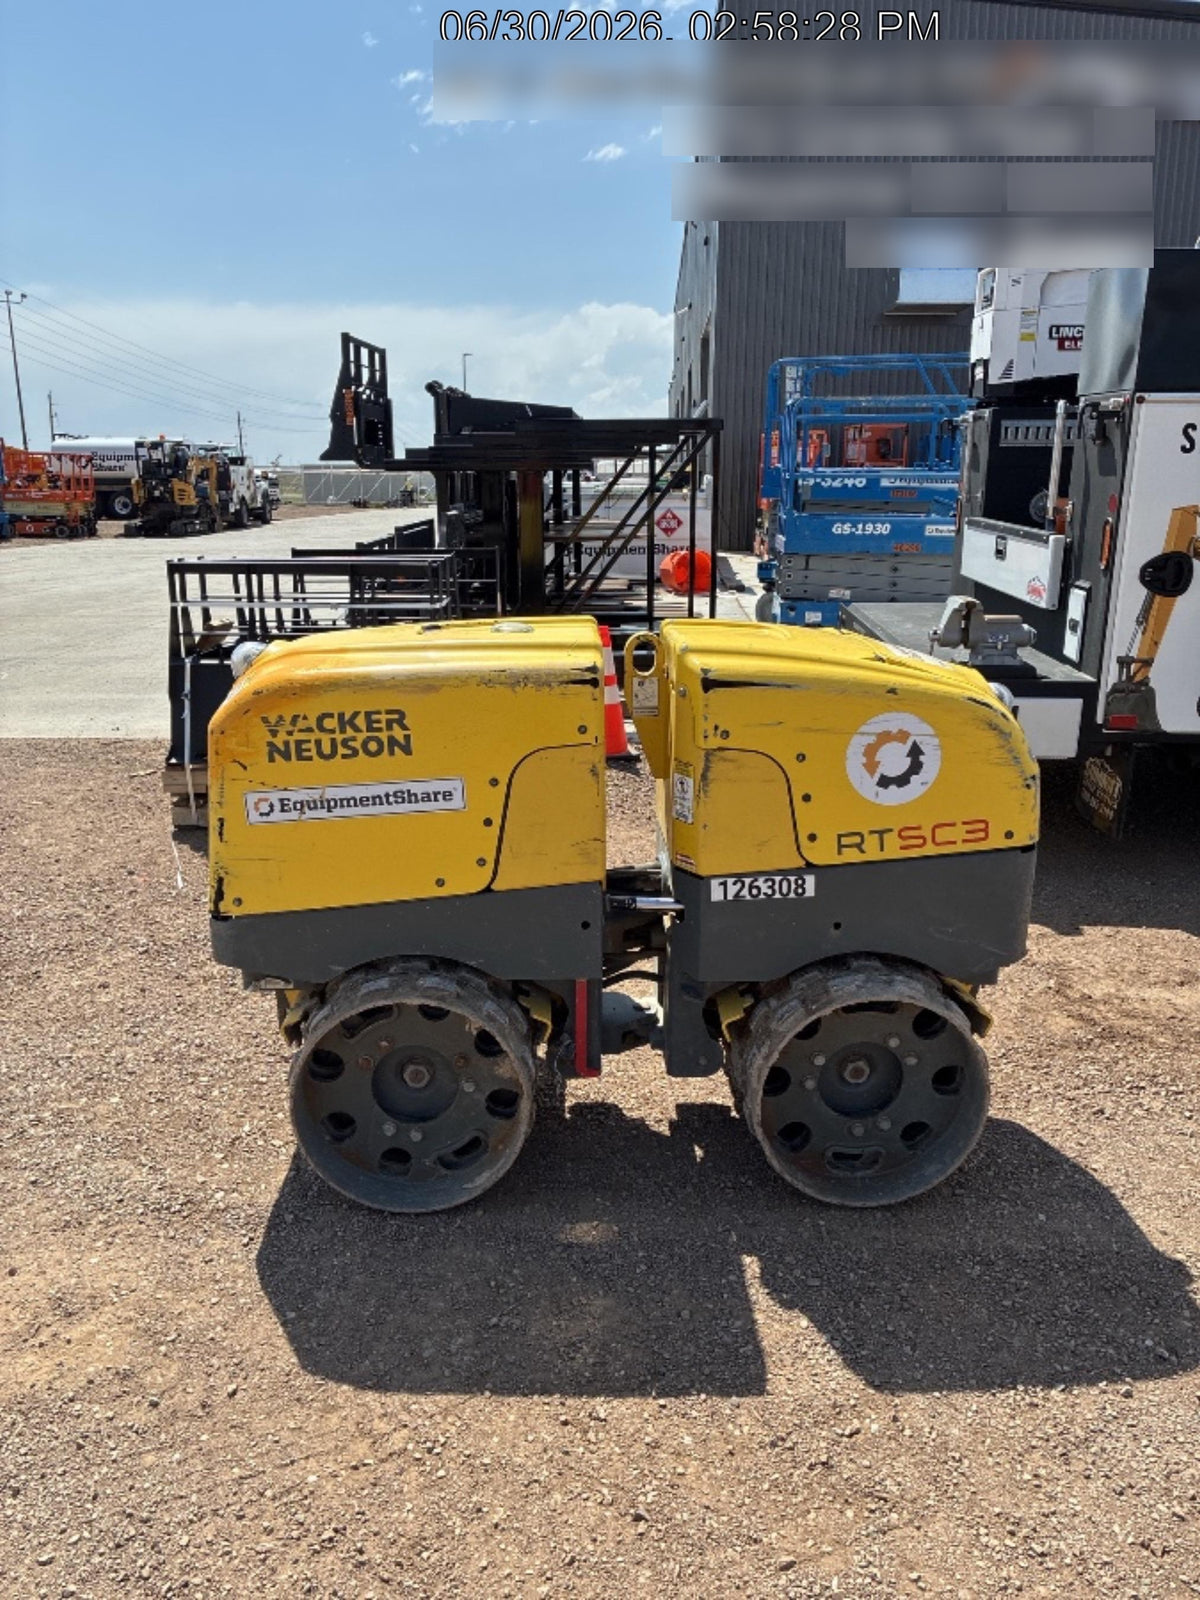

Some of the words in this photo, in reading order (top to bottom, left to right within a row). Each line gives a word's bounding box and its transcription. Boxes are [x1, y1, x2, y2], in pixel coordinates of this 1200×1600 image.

[1051, 325, 1083, 338] LINC
[1180, 422, 1198, 454] S
[831, 522, 891, 535] GS-1930
[261, 709, 411, 738] WACKER
[266, 734, 413, 763] NEUSON
[279, 788, 454, 813] EquipmentShare
[836, 818, 990, 856] RTSC3
[717, 876, 806, 900] 126308
